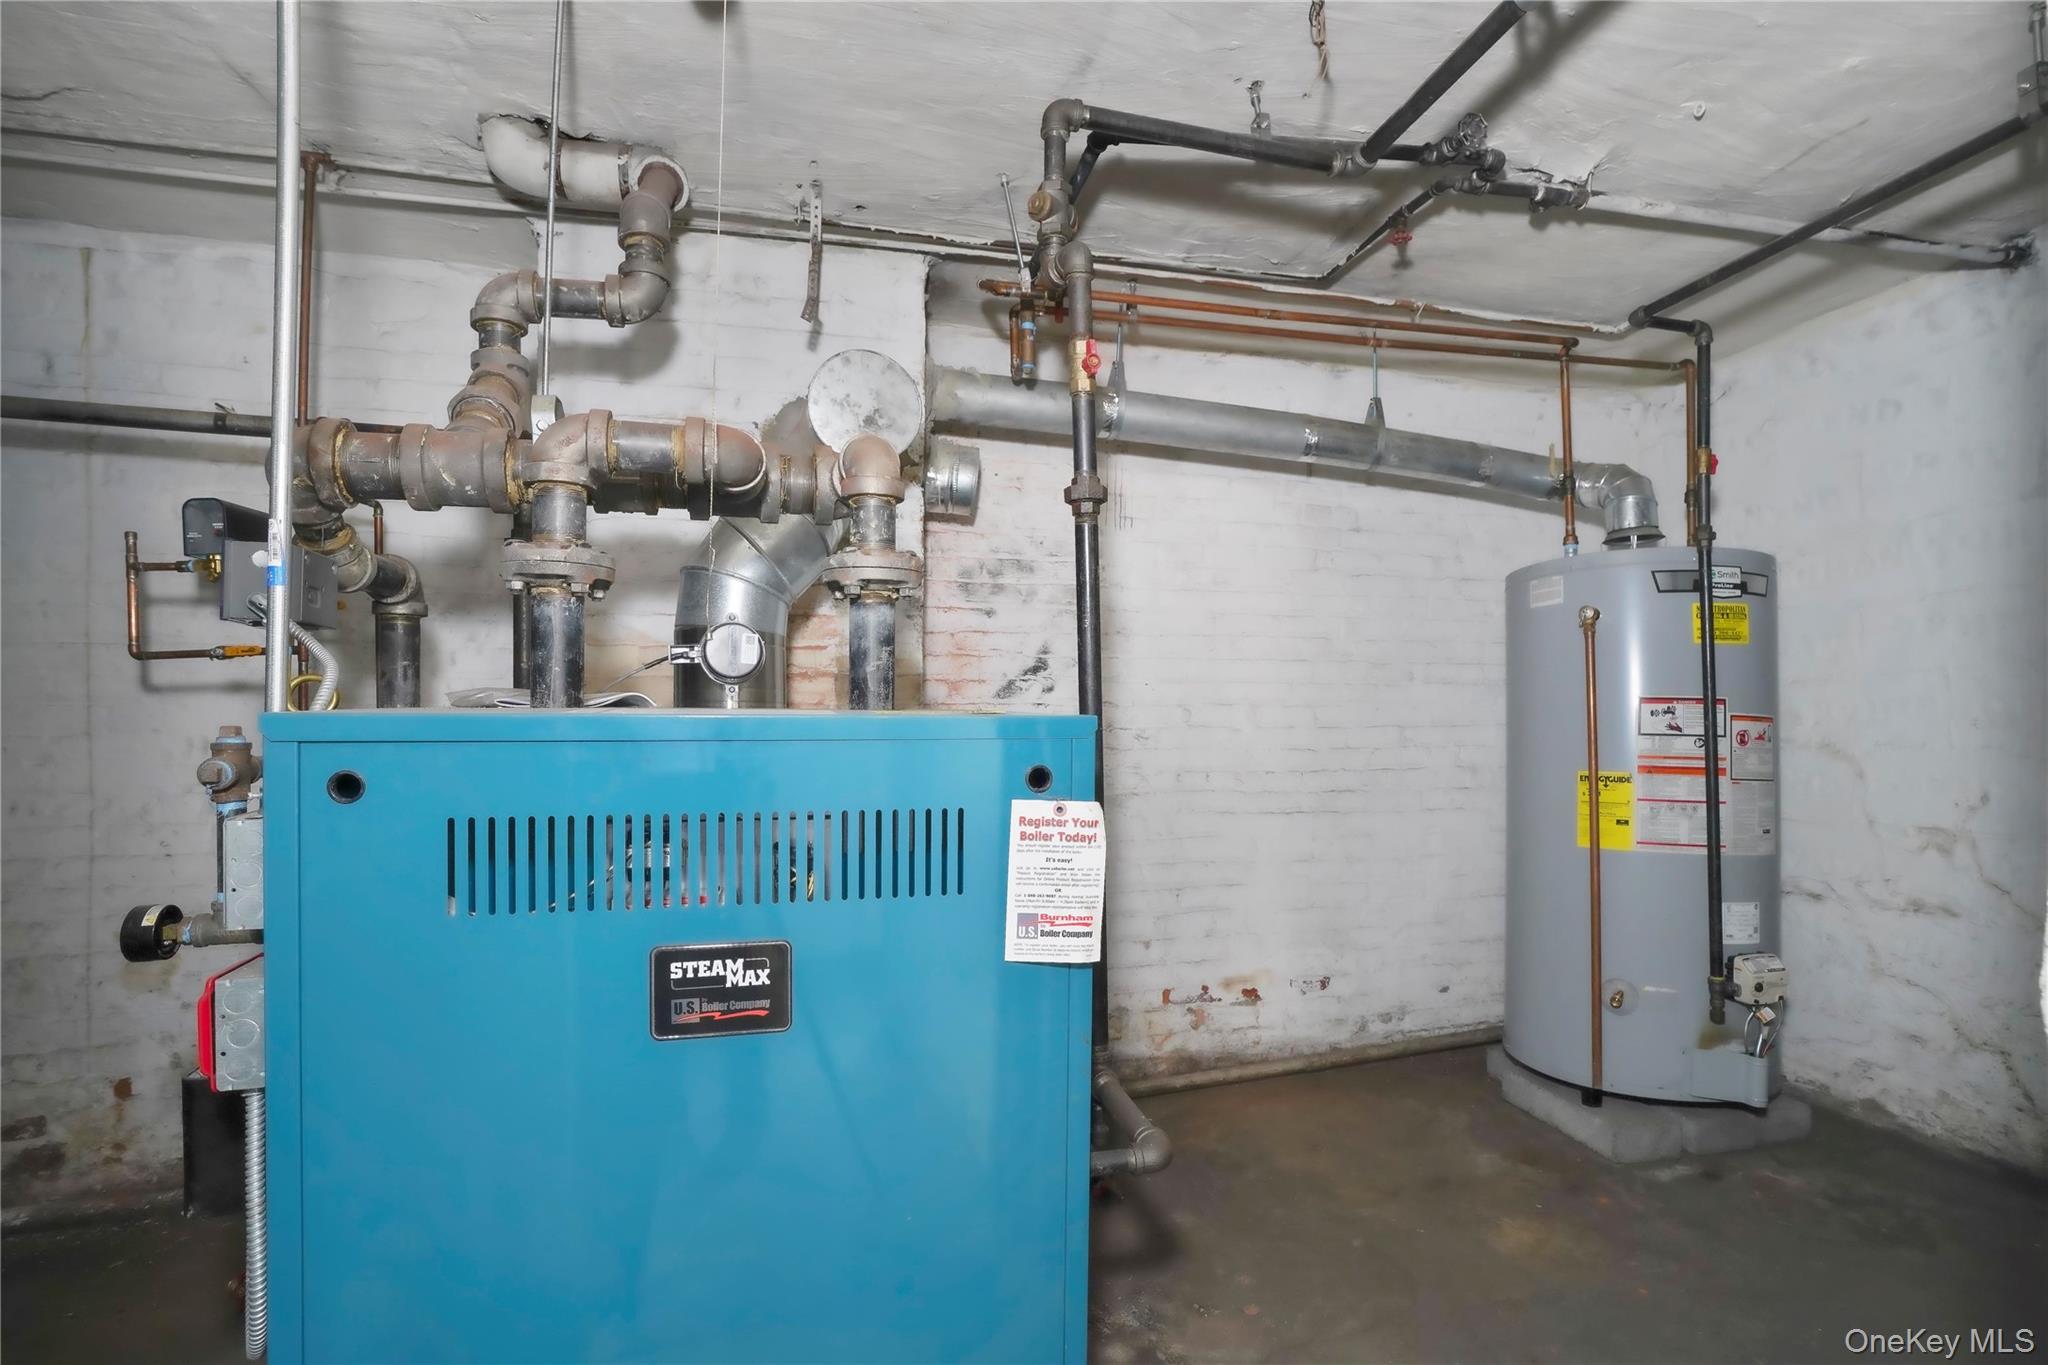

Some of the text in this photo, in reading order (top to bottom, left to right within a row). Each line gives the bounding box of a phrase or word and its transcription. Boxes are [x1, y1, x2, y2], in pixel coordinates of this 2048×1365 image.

[1717, 571, 1739, 579] Smith
[1018, 816, 1099, 829] Register Your
[1019, 831, 1097, 844] Boiler Today!
[1039, 913, 1094, 922] Burnham
[1018, 926, 1093, 939] U.S. Boiler Company
[669, 958, 745, 980] STEAM
[725, 968, 771, 988] MAX
[674, 999, 770, 1015] U.S. Boiler Company
